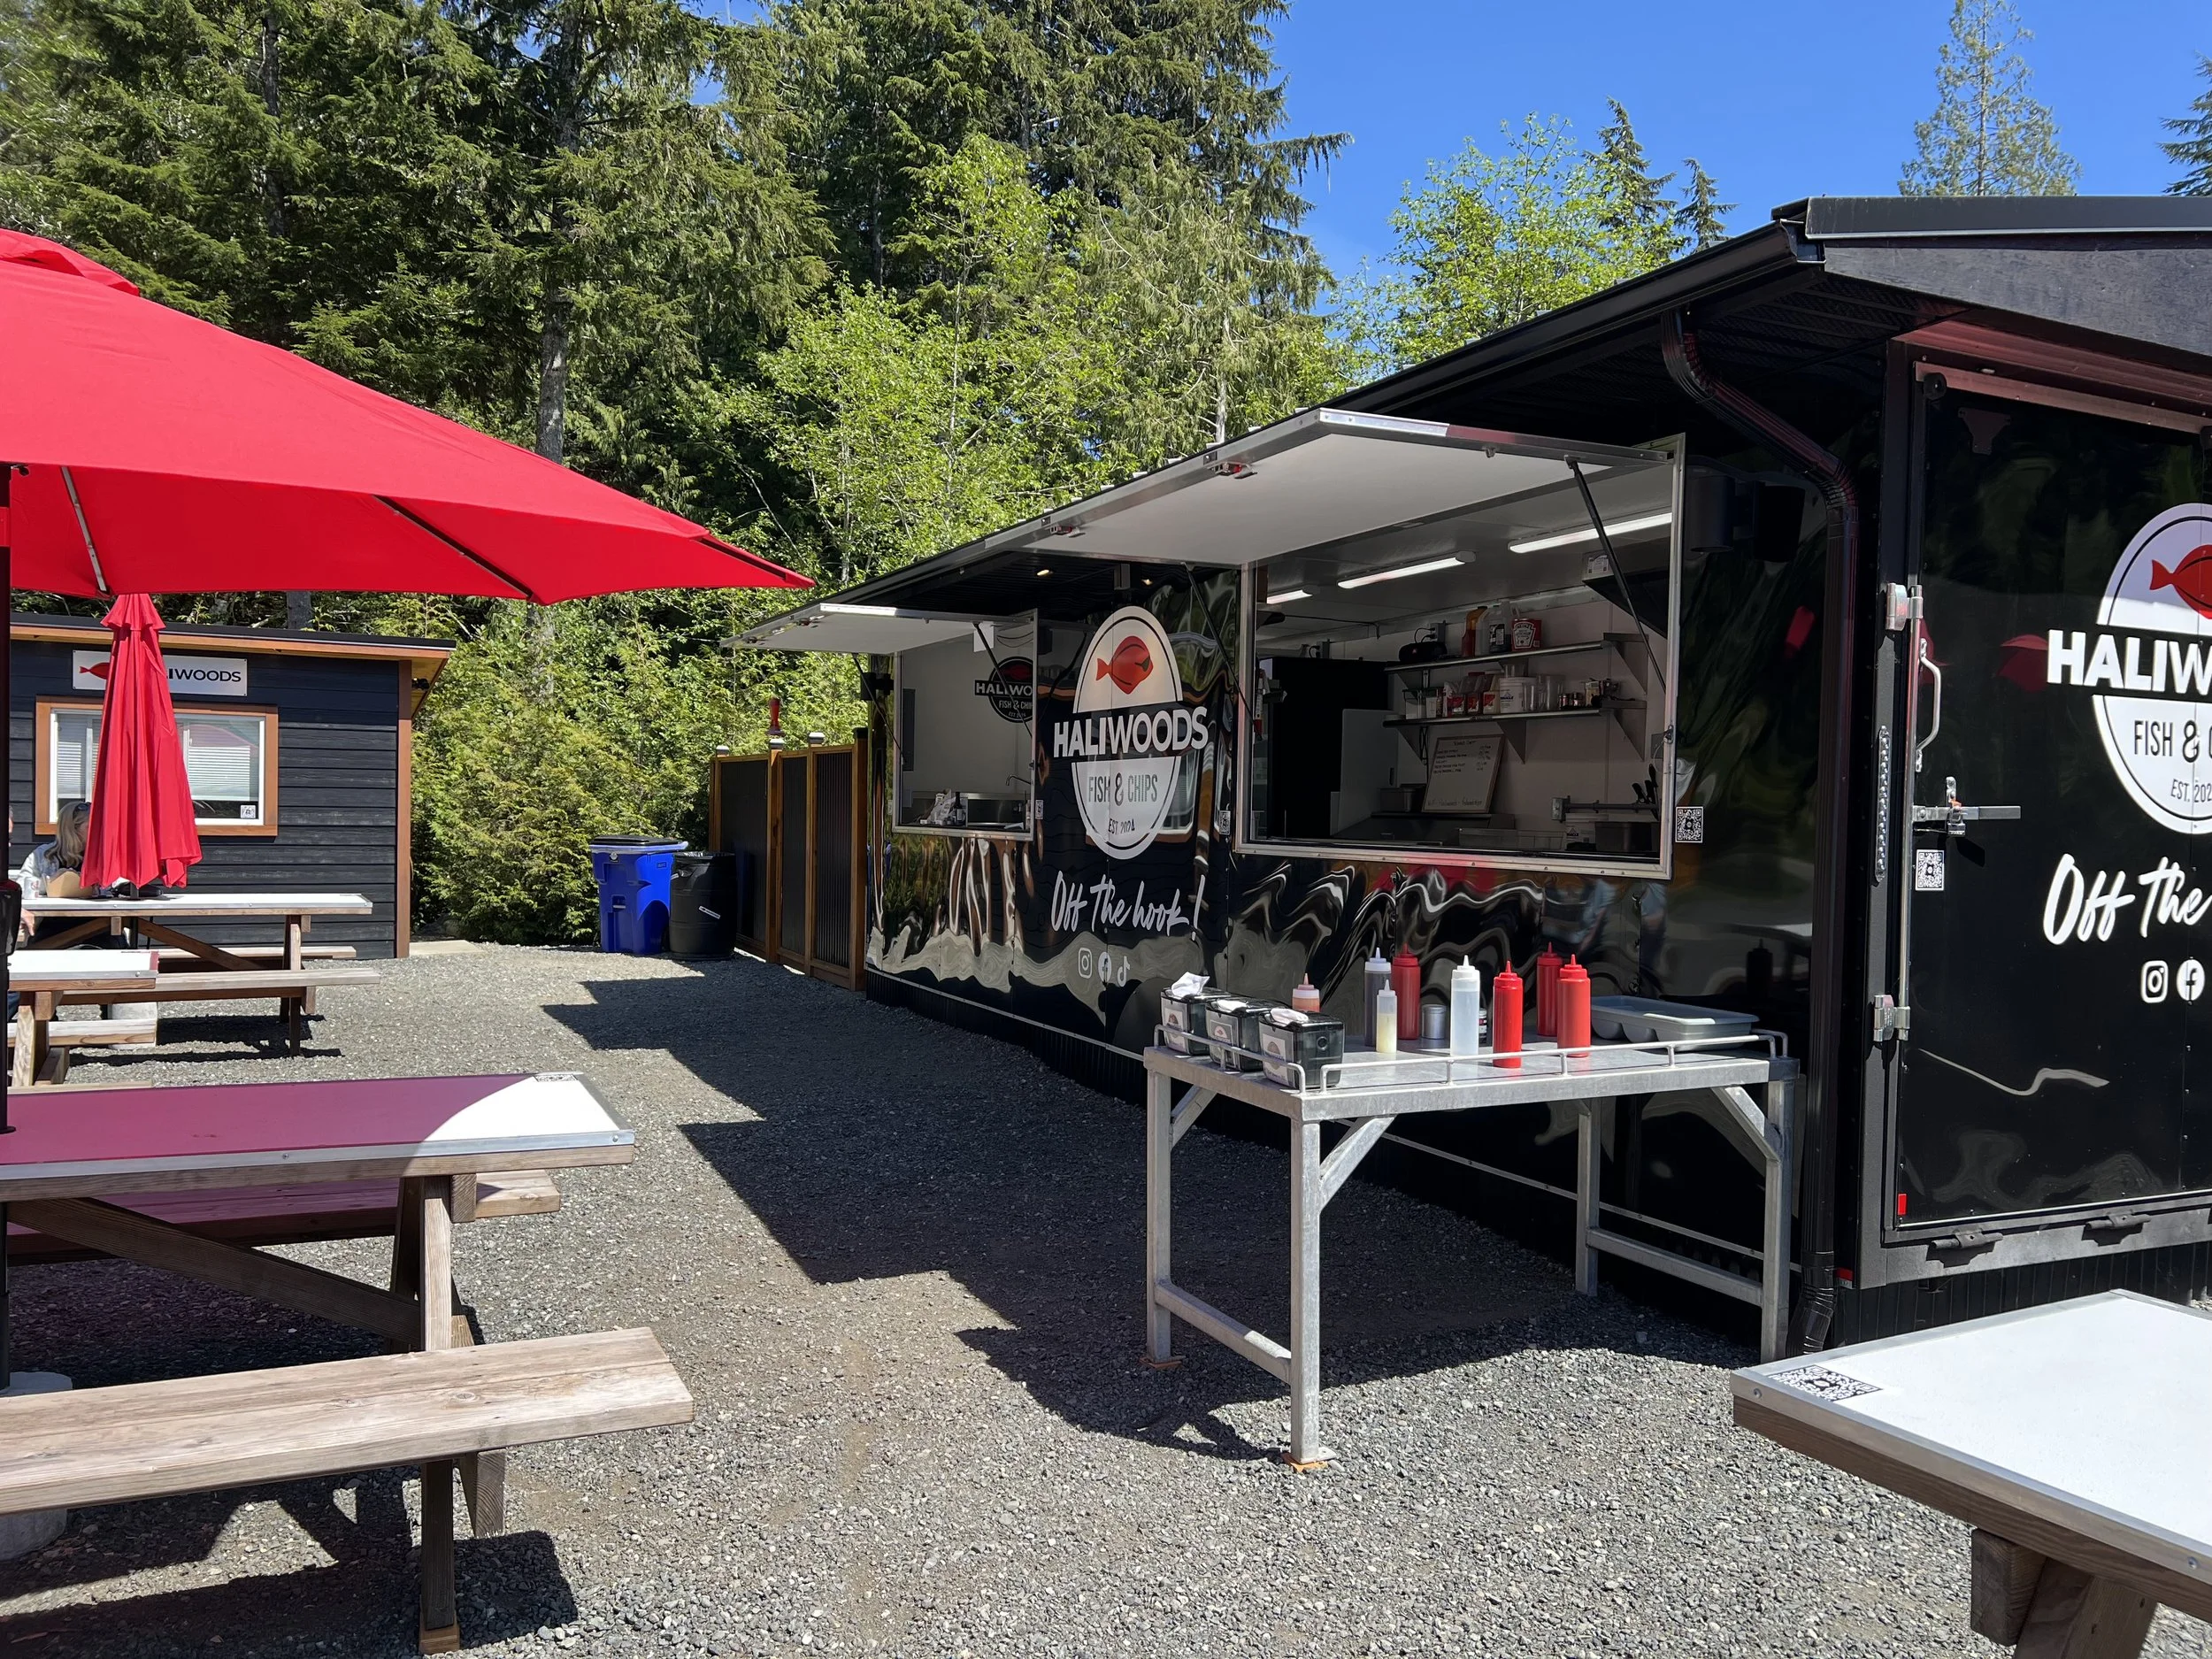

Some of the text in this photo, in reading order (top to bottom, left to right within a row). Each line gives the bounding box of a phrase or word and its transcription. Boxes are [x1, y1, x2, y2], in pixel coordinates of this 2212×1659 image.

[166, 668, 242, 682] IWOODS
[2047, 629, 2212, 695] HALIW
[976, 682, 1033, 695] HALIWO
[999, 700, 1011, 709] FISH
[1053, 706, 1209, 757] HALIWOODS
[2134, 720, 2173, 757] FISH
[2182, 719, 2200, 763] &
[1088, 772, 1158, 806] FISH & CHIPS
[2171, 779, 2212, 803] EST. 202
[1051, 871, 1087, 932] Off
[2043, 853, 2136, 945] Off
